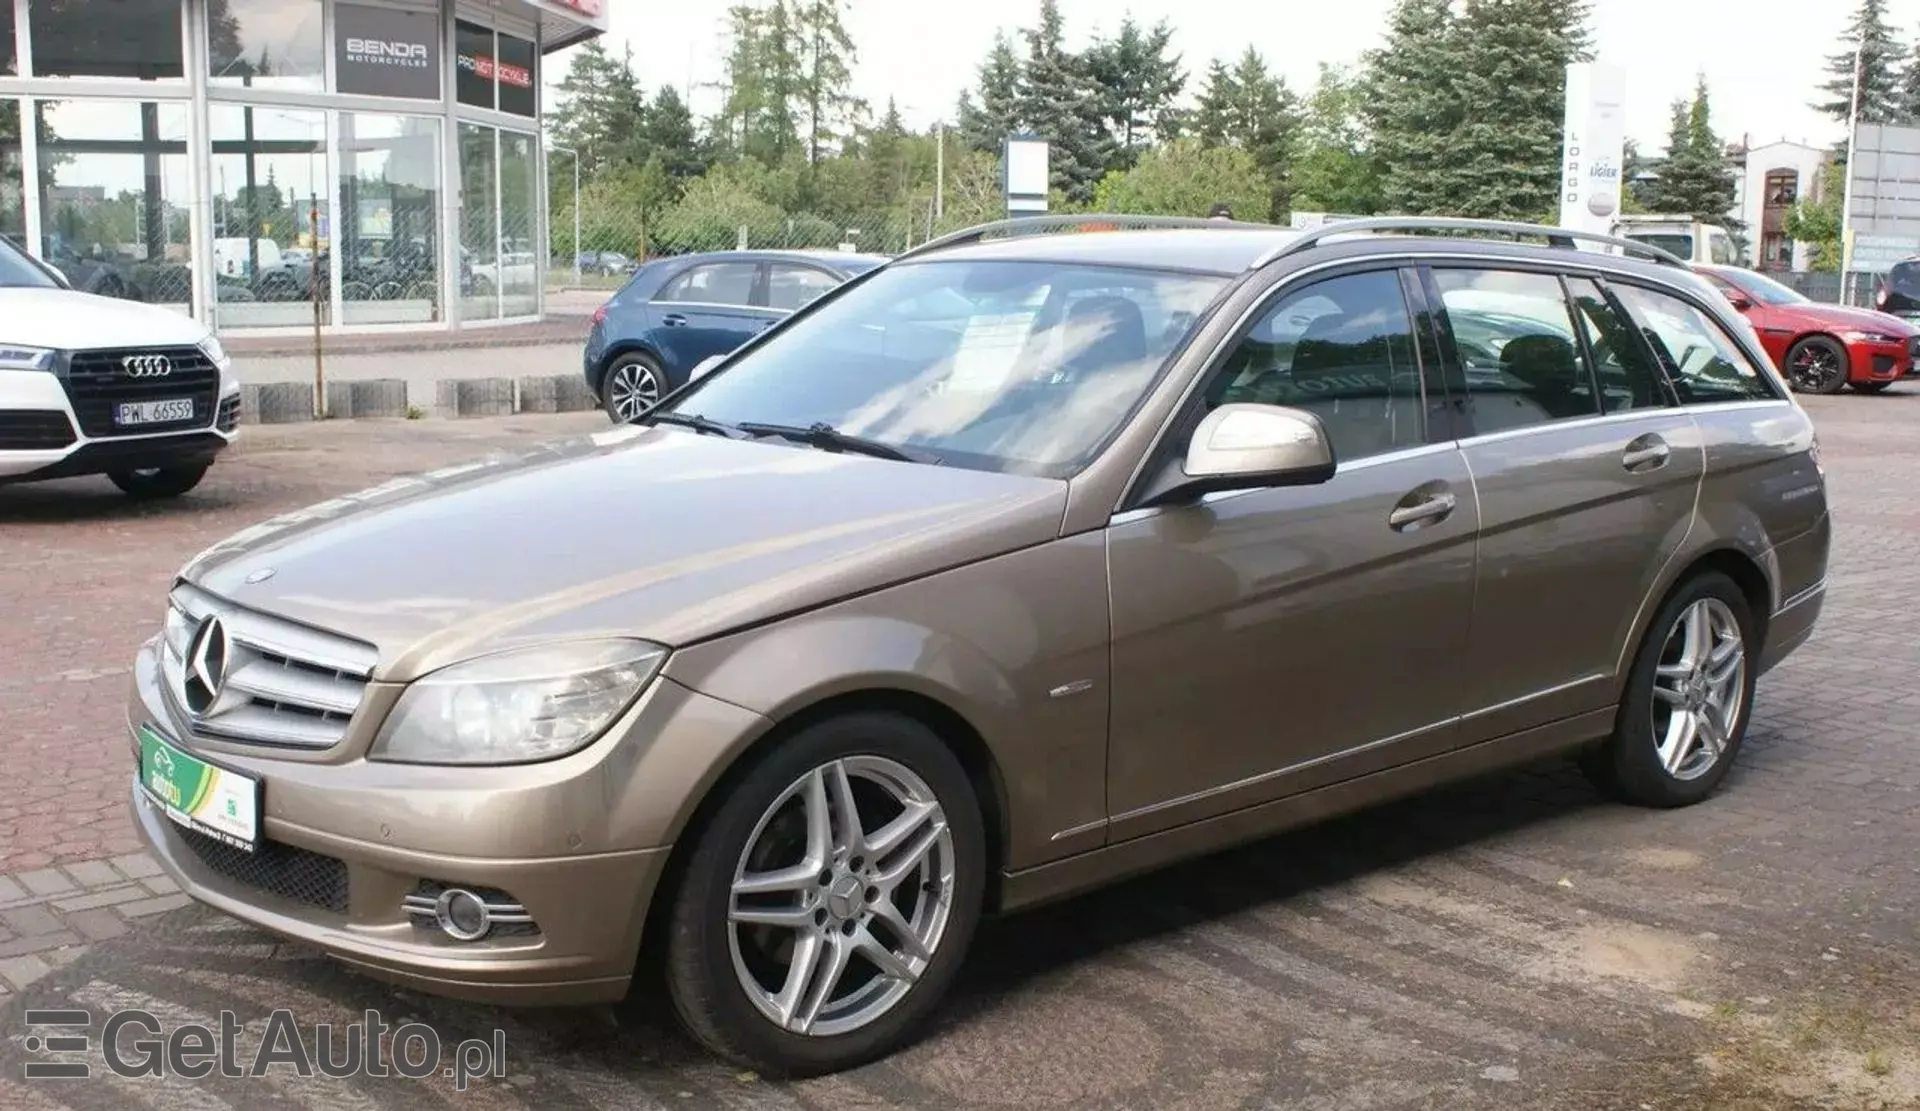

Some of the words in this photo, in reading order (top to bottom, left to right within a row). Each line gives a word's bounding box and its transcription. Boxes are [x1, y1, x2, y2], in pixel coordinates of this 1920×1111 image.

[346, 38, 427, 58] BENDA
[347, 54, 428, 68] MOTORCYCLES
[121, 404, 149, 424] PWL
[153, 401, 192, 420] 66559
